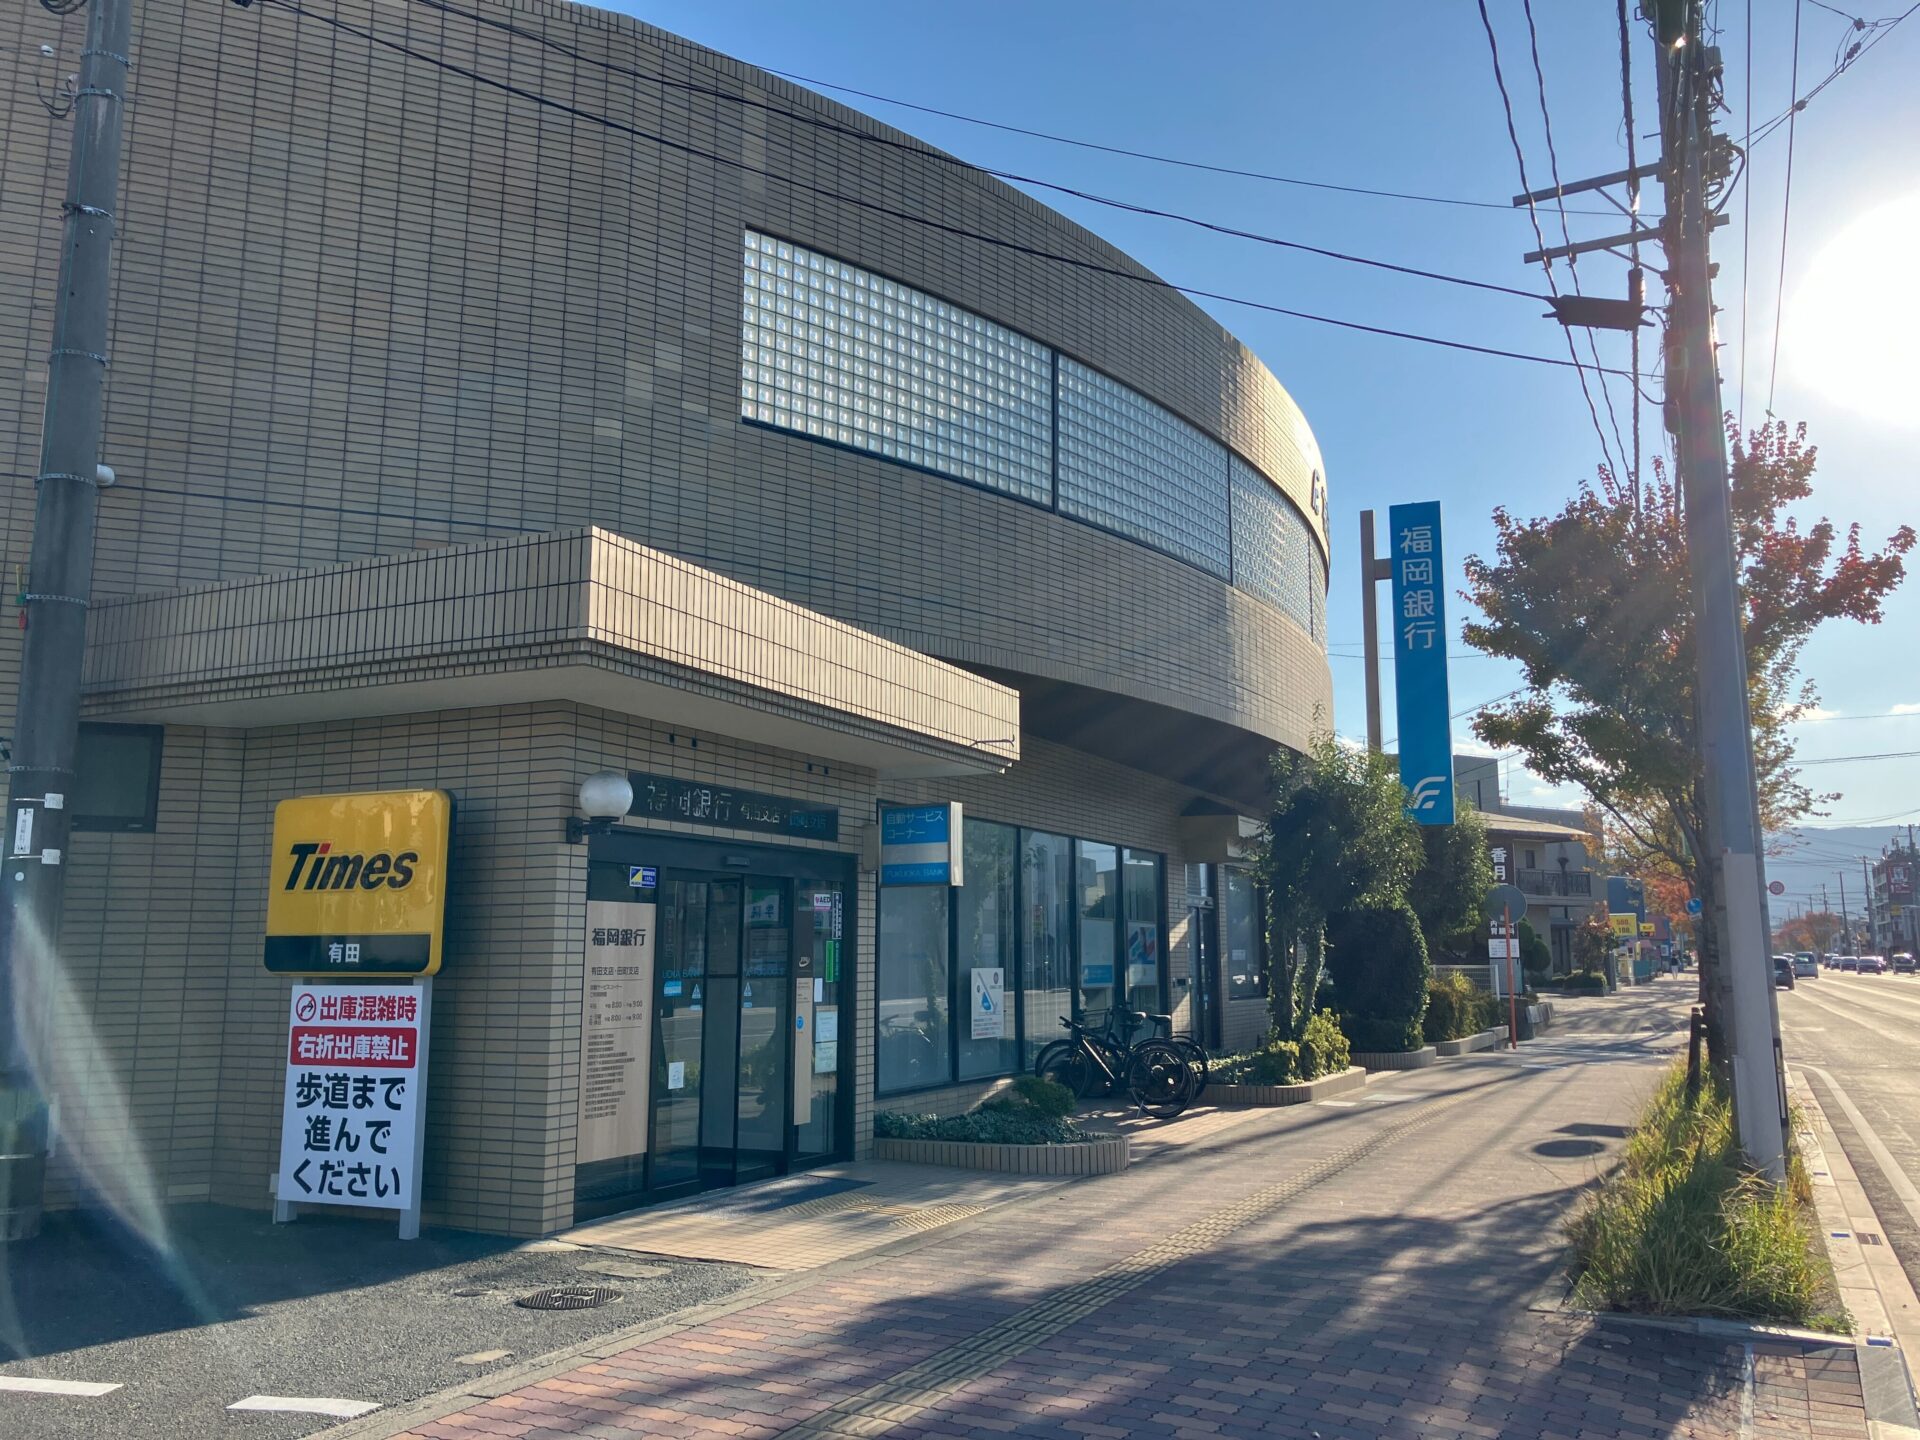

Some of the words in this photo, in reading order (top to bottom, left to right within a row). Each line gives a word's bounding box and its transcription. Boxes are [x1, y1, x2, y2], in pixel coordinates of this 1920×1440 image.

[1399, 525, 1437, 650] 福岡銀行
[887, 810, 944, 825] 自動サービス
[887, 827, 926, 839] コーナー
[283, 840, 419, 892] Times
[923, 868, 945, 877] BANK
[1490, 847, 1508, 885] 香月
[819, 896, 831, 904] AED
[591, 928, 646, 947] 福岡銀行
[328, 942, 360, 964] 有田
[319, 995, 417, 1022] 出庫混雑時
[298, 1034, 409, 1061] 右折出庫禁止
[296, 1072, 406, 1111] 歩道まで
[304, 1115, 391, 1154] 進んで
[293, 1158, 400, 1198] ください
